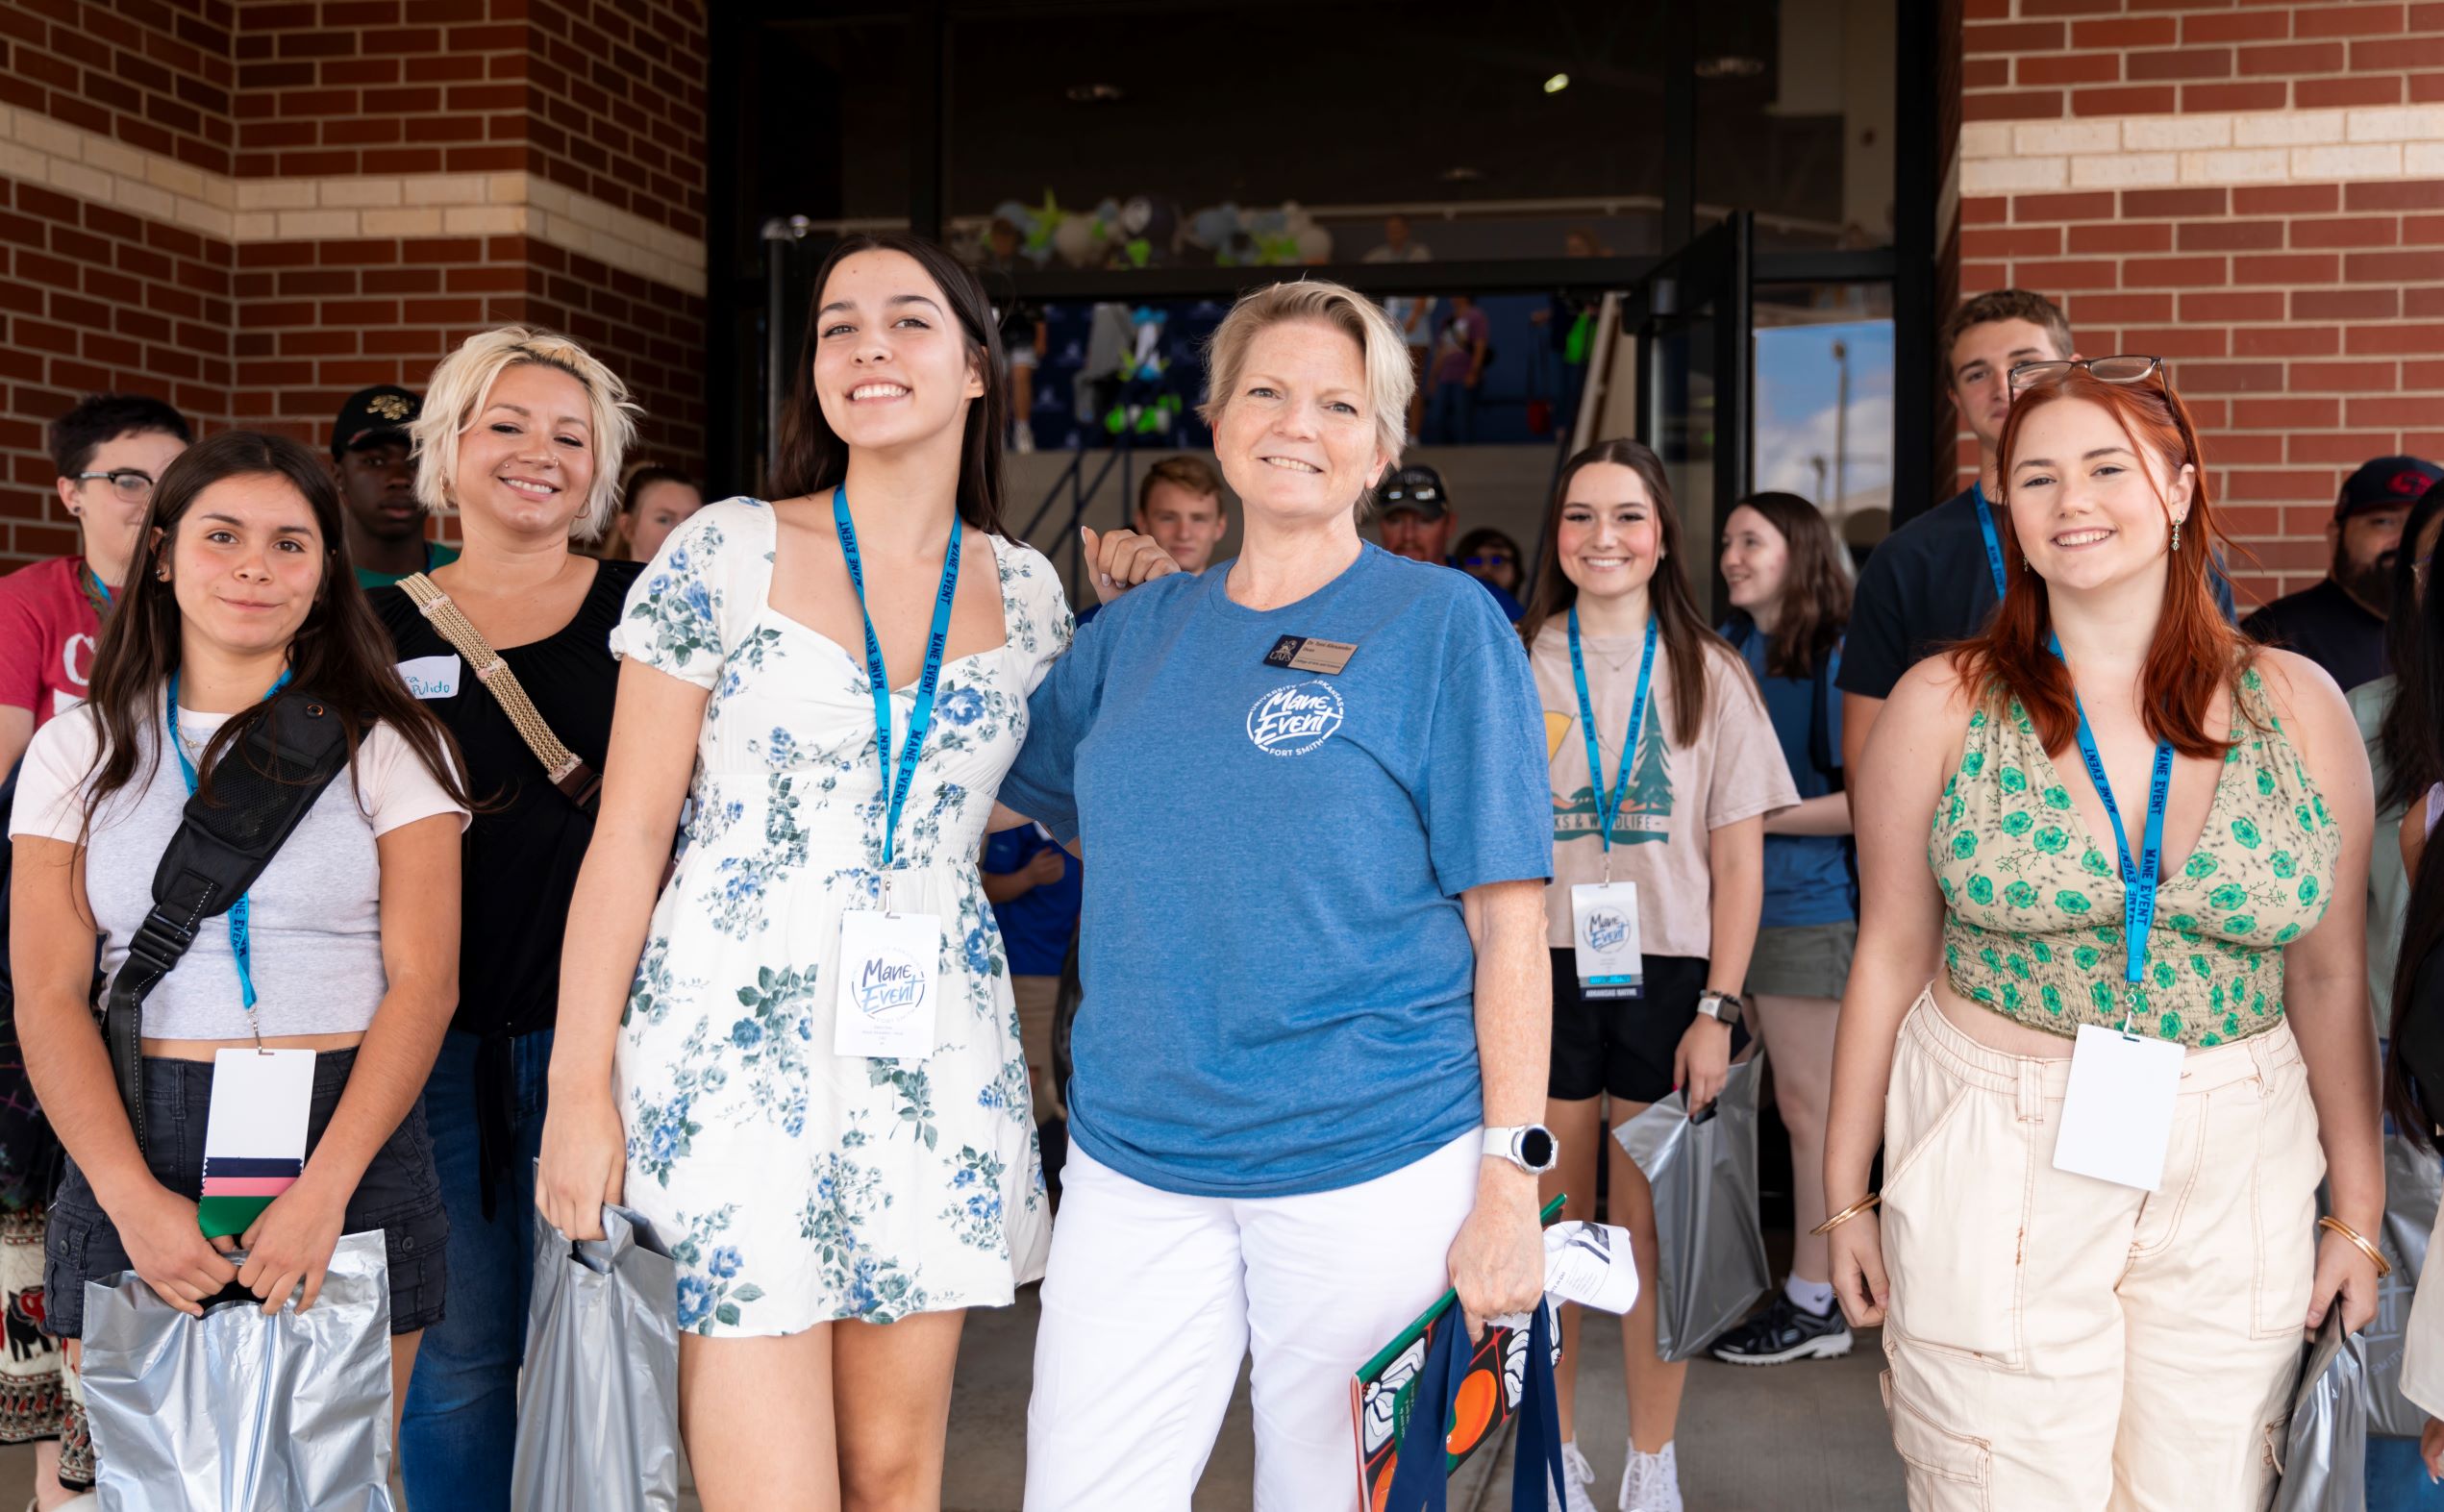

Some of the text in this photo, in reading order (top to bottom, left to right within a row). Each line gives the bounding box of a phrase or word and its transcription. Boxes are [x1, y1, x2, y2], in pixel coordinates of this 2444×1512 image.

[838, 521, 862, 587] MANE EVENT
[939, 541, 960, 606] MANE EVENT
[870, 658, 885, 690] MANE
[922, 632, 944, 697] MANE EVENT
[411, 680, 450, 695] Pulido
[1251, 684, 1297, 711] UNIVERSITY
[1259, 688, 1332, 719] Mane
[1312, 680, 1344, 707] ARKANSAS
[1254, 706, 1344, 746] Event
[880, 727, 889, 766] EVENT
[1269, 737, 1324, 756] FORT SMITH
[895, 730, 922, 807] MANE EVENT
[2083, 747, 2116, 814] MANE EVENT
[2151, 746, 2171, 816] MANE EVENT
[1575, 815, 1583, 829] &
[1588, 814, 1651, 830] WDLIFE
[2120, 846, 2136, 884] EVENT
[2136, 848, 2157, 926] MANE EVENT
[233, 919, 244, 954] EVEN
[862, 957, 912, 988] Mane
[861, 975, 925, 1013] Event
